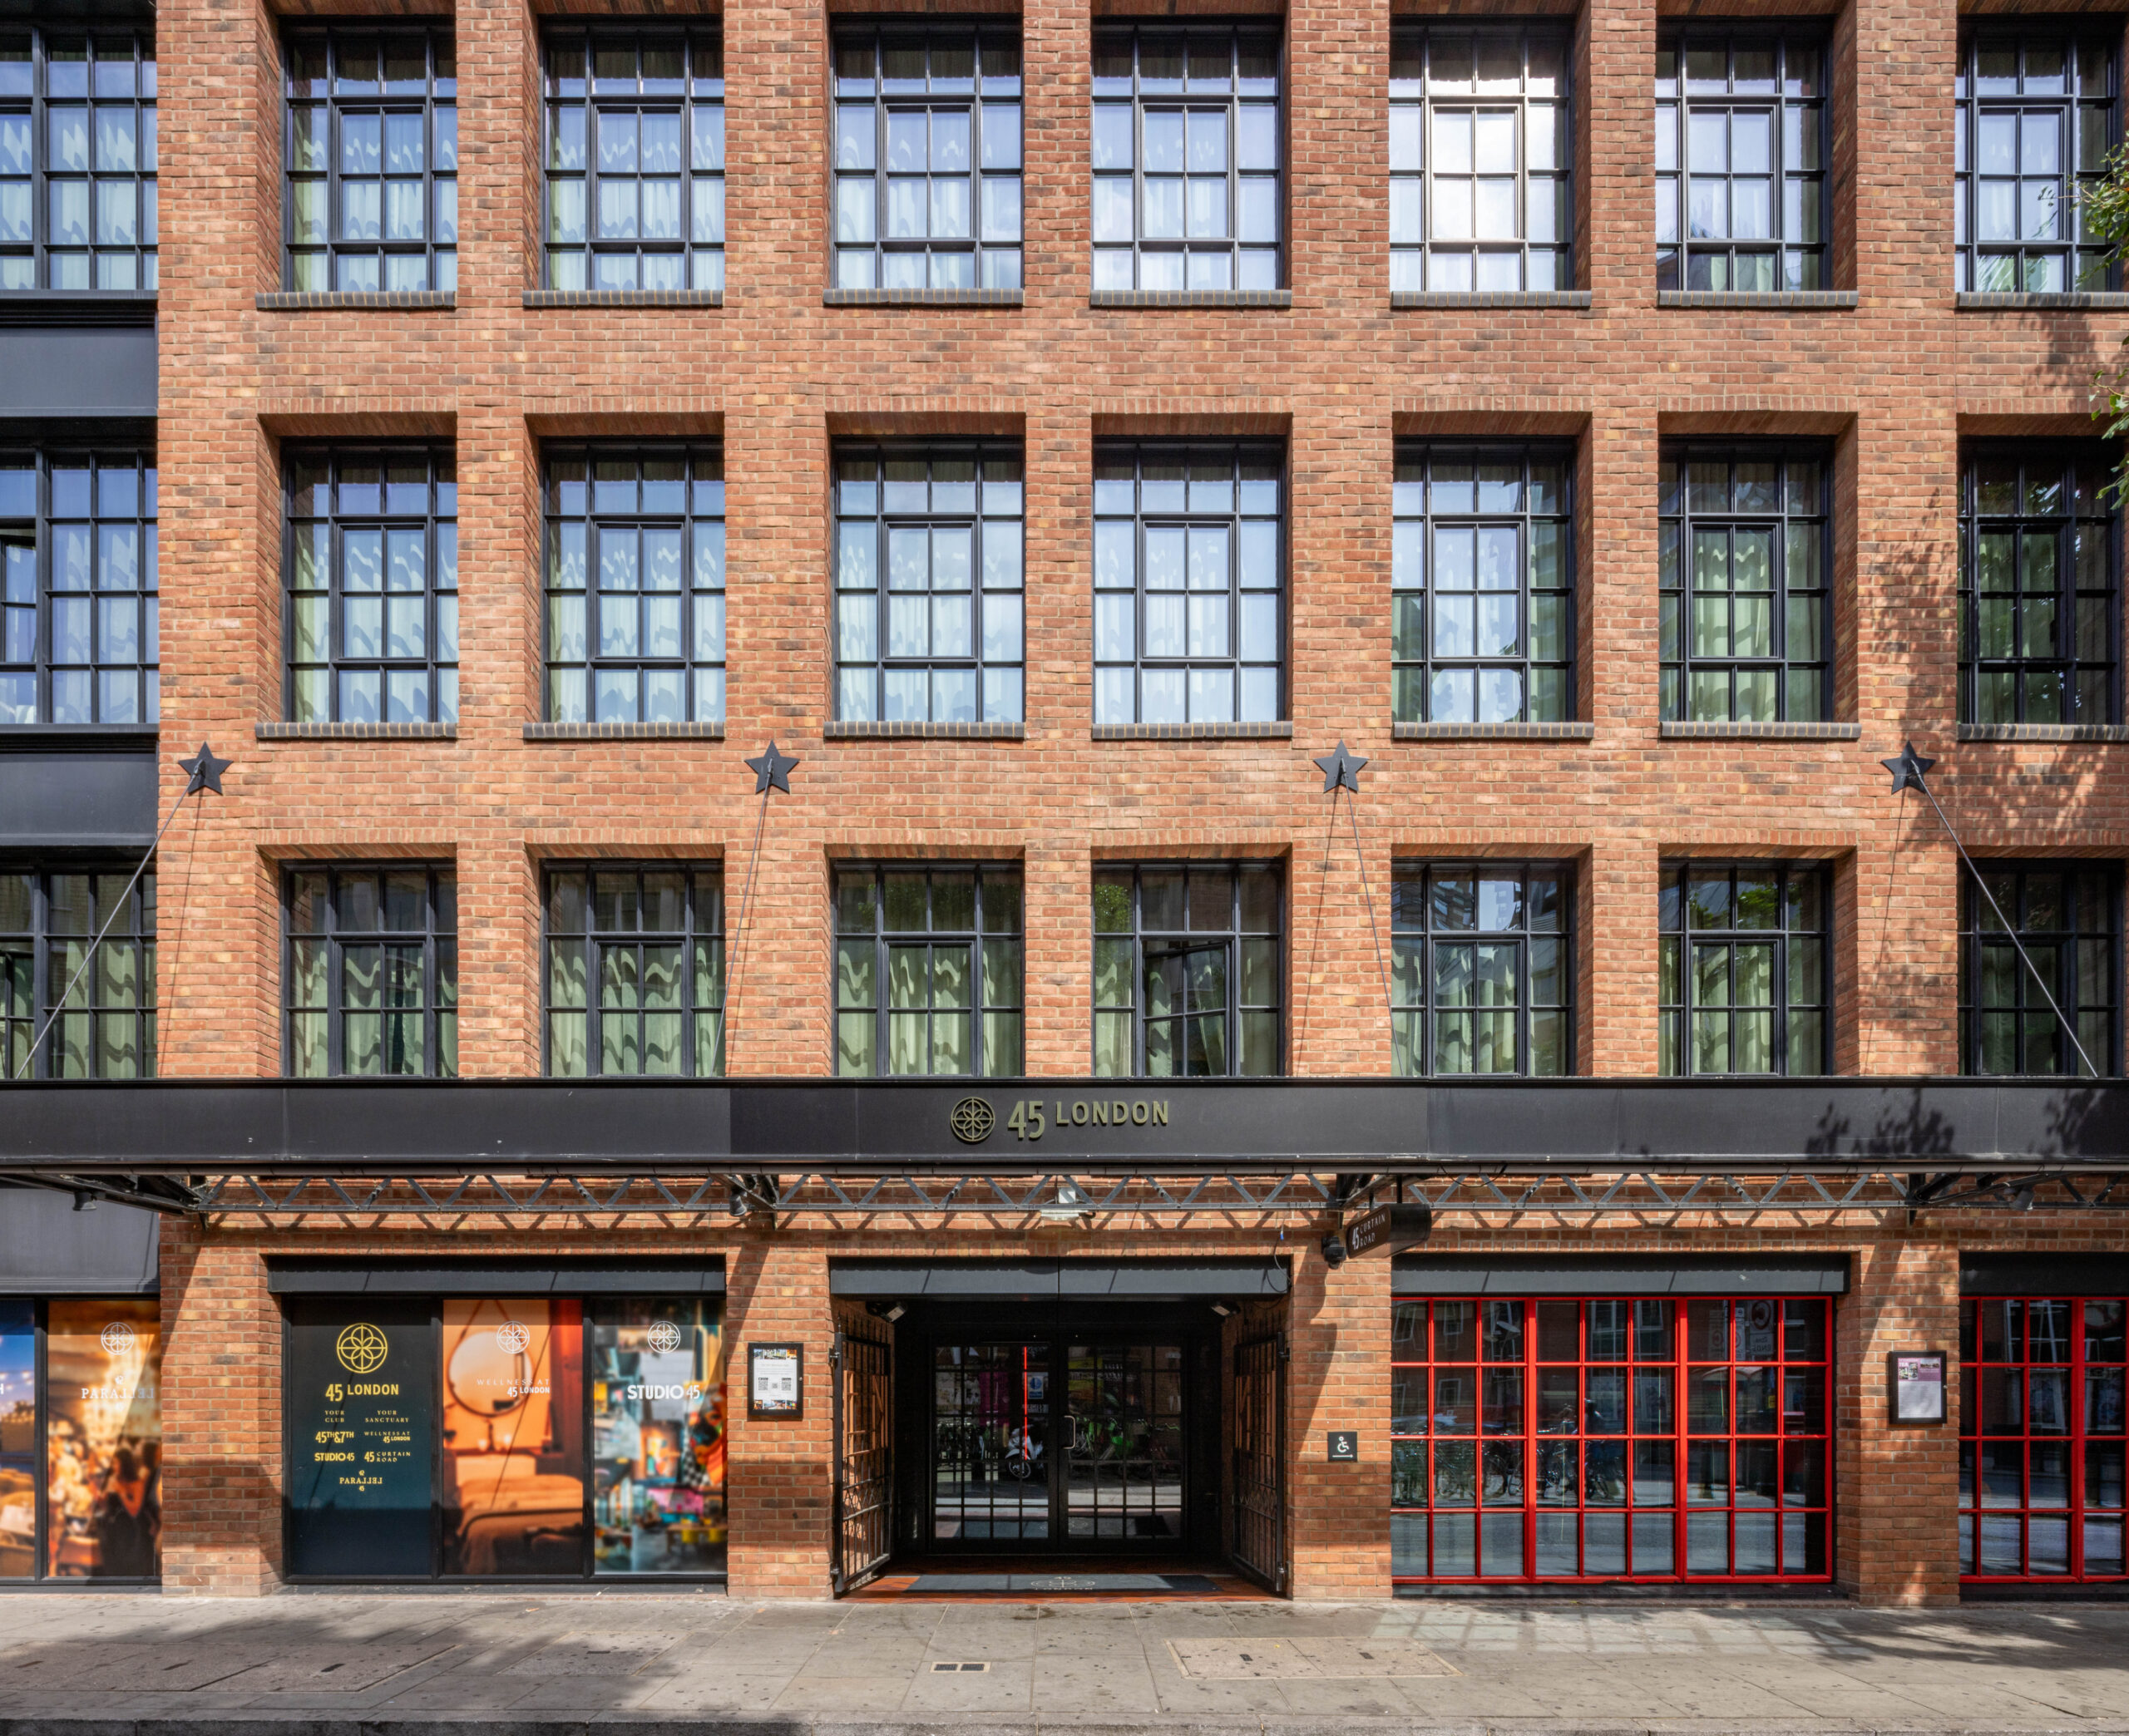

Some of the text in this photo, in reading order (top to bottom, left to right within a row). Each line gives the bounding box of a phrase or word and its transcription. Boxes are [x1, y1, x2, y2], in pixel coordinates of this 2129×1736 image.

[1007, 1100, 1168, 1140] 45 LONDON
[1351, 1213, 1386, 1250] 45 CURTAIN
[1360, 1232, 1376, 1247] ROAD
[324, 1383, 399, 1402] 45 LONDON
[506, 1386, 550, 1397] 45 LONDON
[627, 1384, 700, 1400] STUDIO 45
[315, 1431, 354, 1443] 45TH&7TH
[314, 1452, 355, 1462] STUDIO 45
[363, 1451, 375, 1462] 45
